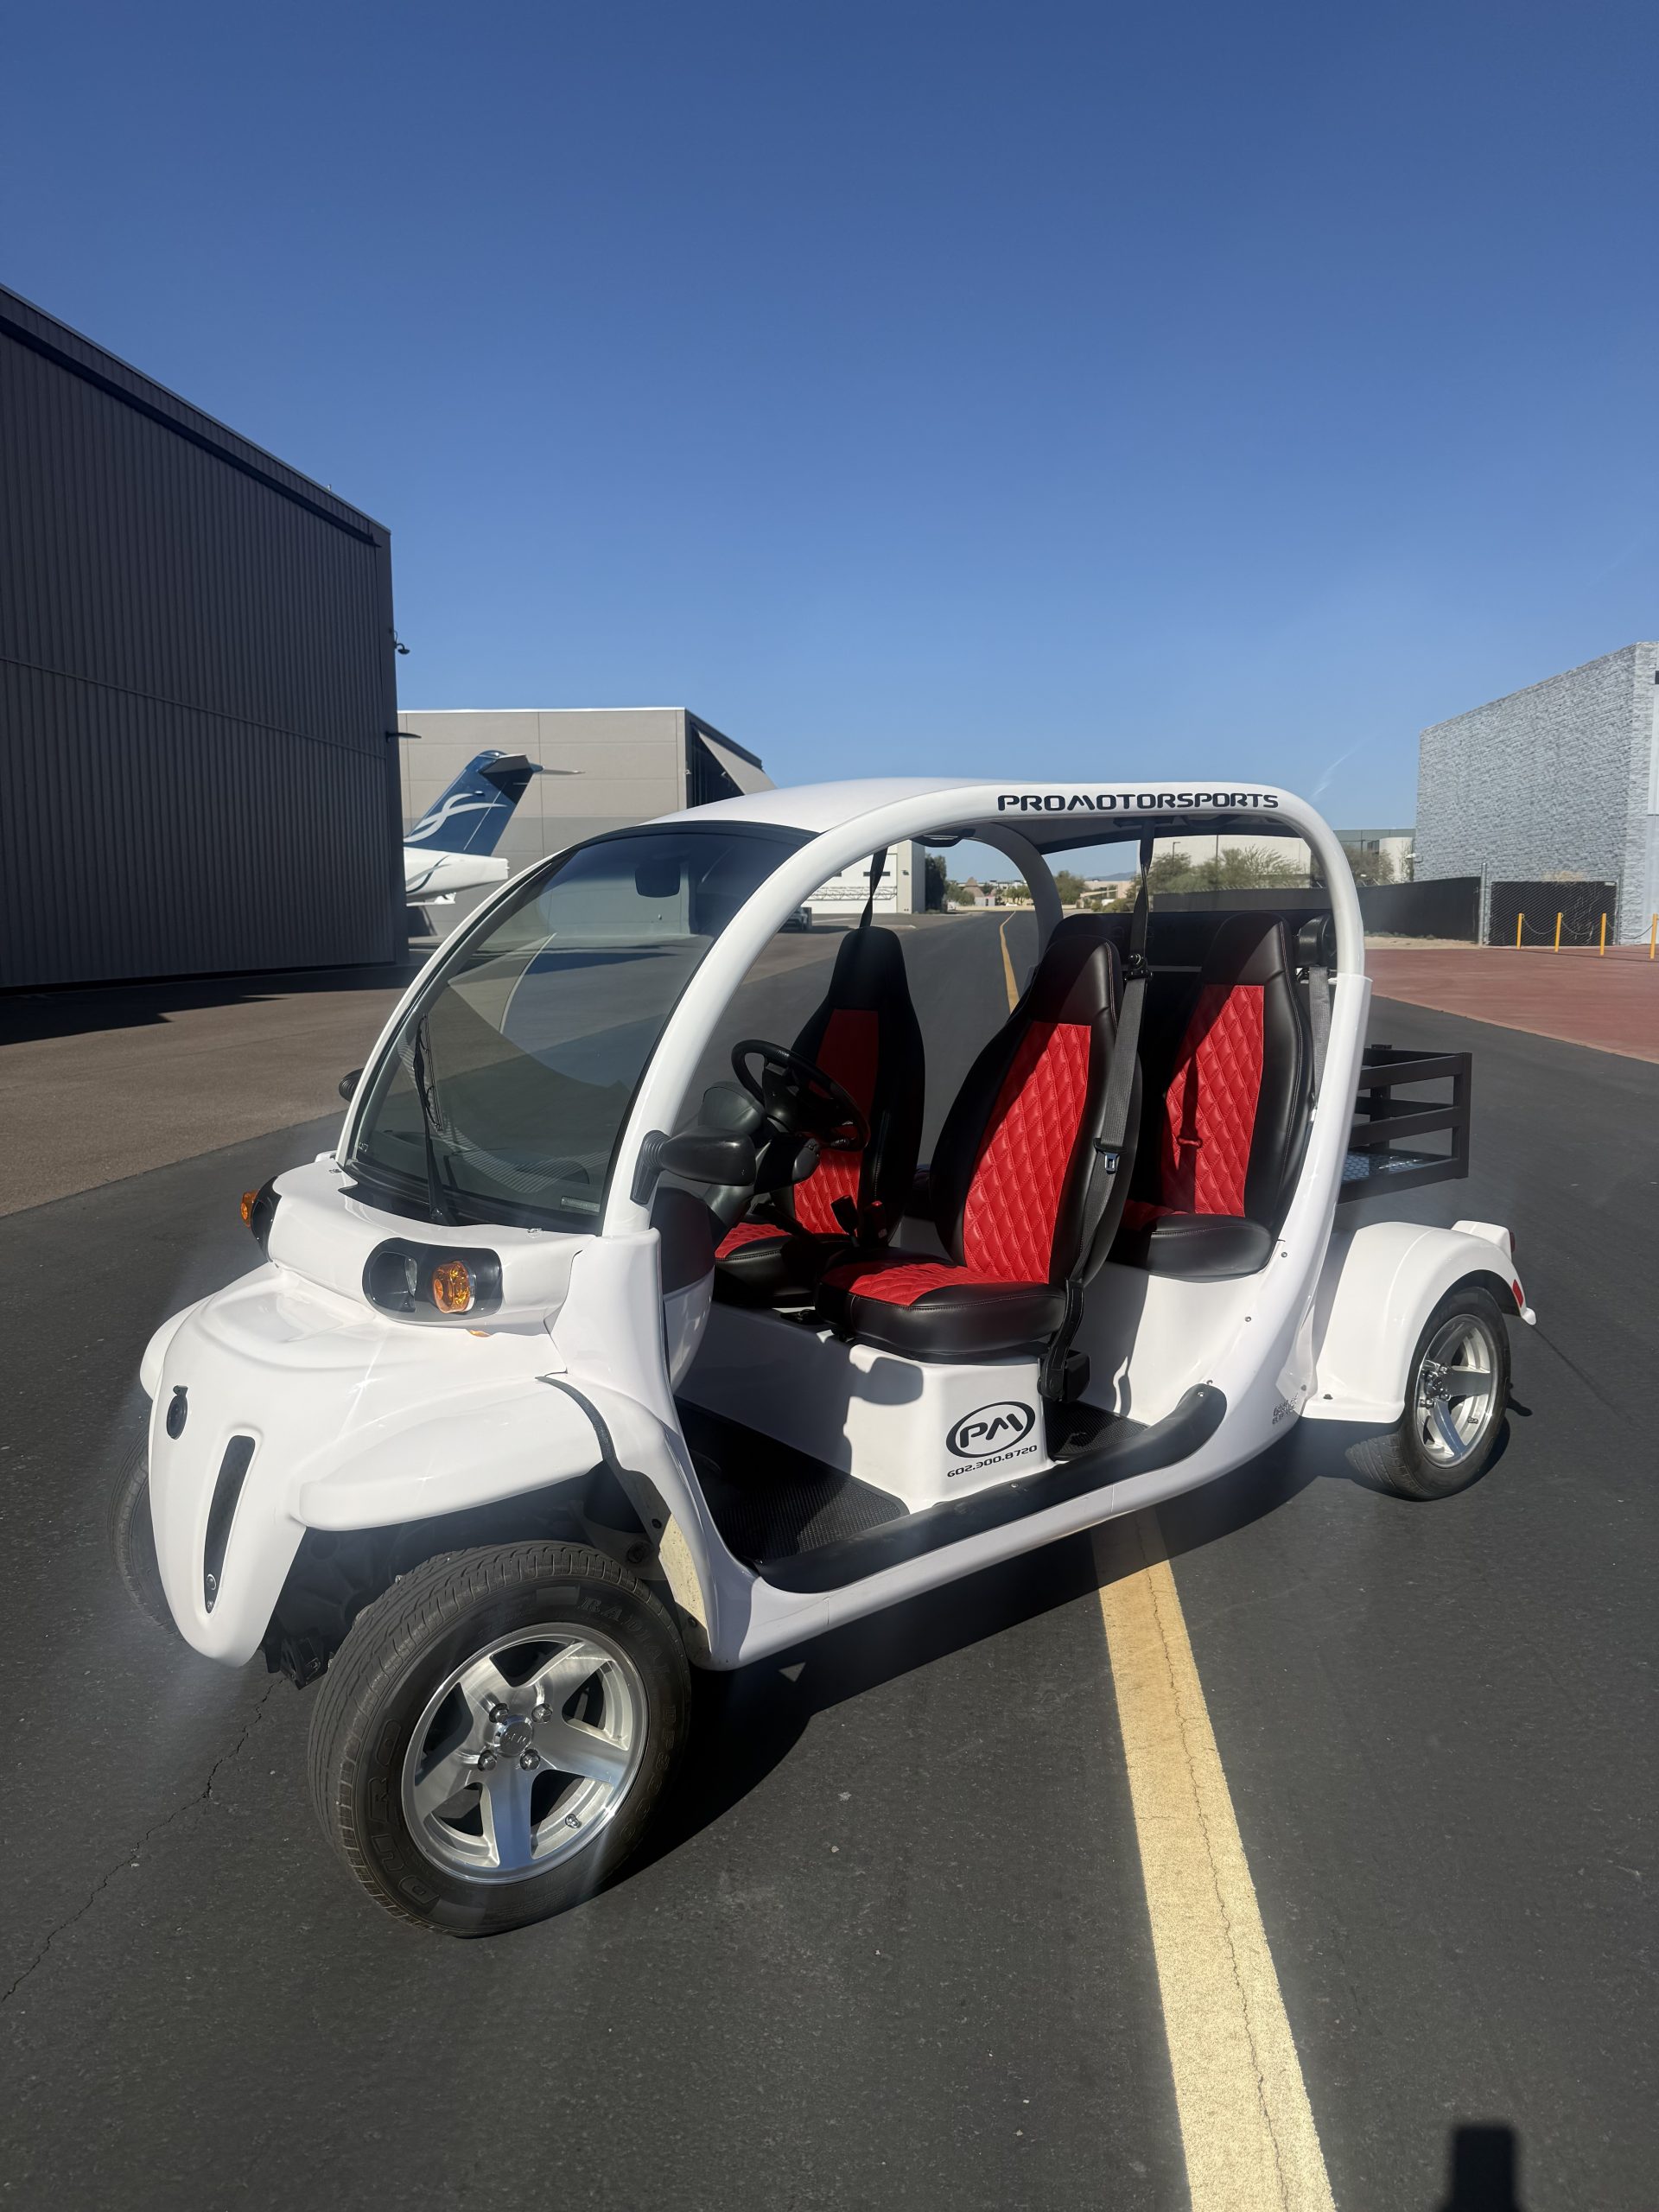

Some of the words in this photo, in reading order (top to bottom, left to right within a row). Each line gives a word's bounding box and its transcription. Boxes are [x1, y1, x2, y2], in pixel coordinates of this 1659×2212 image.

[997, 793, 1279, 811] PROMOTORSPORTS
[959, 1413, 1024, 1448] PM
[947, 1445, 1038, 1478] 602.300.8720
[367, 1719, 441, 1909] DURO
